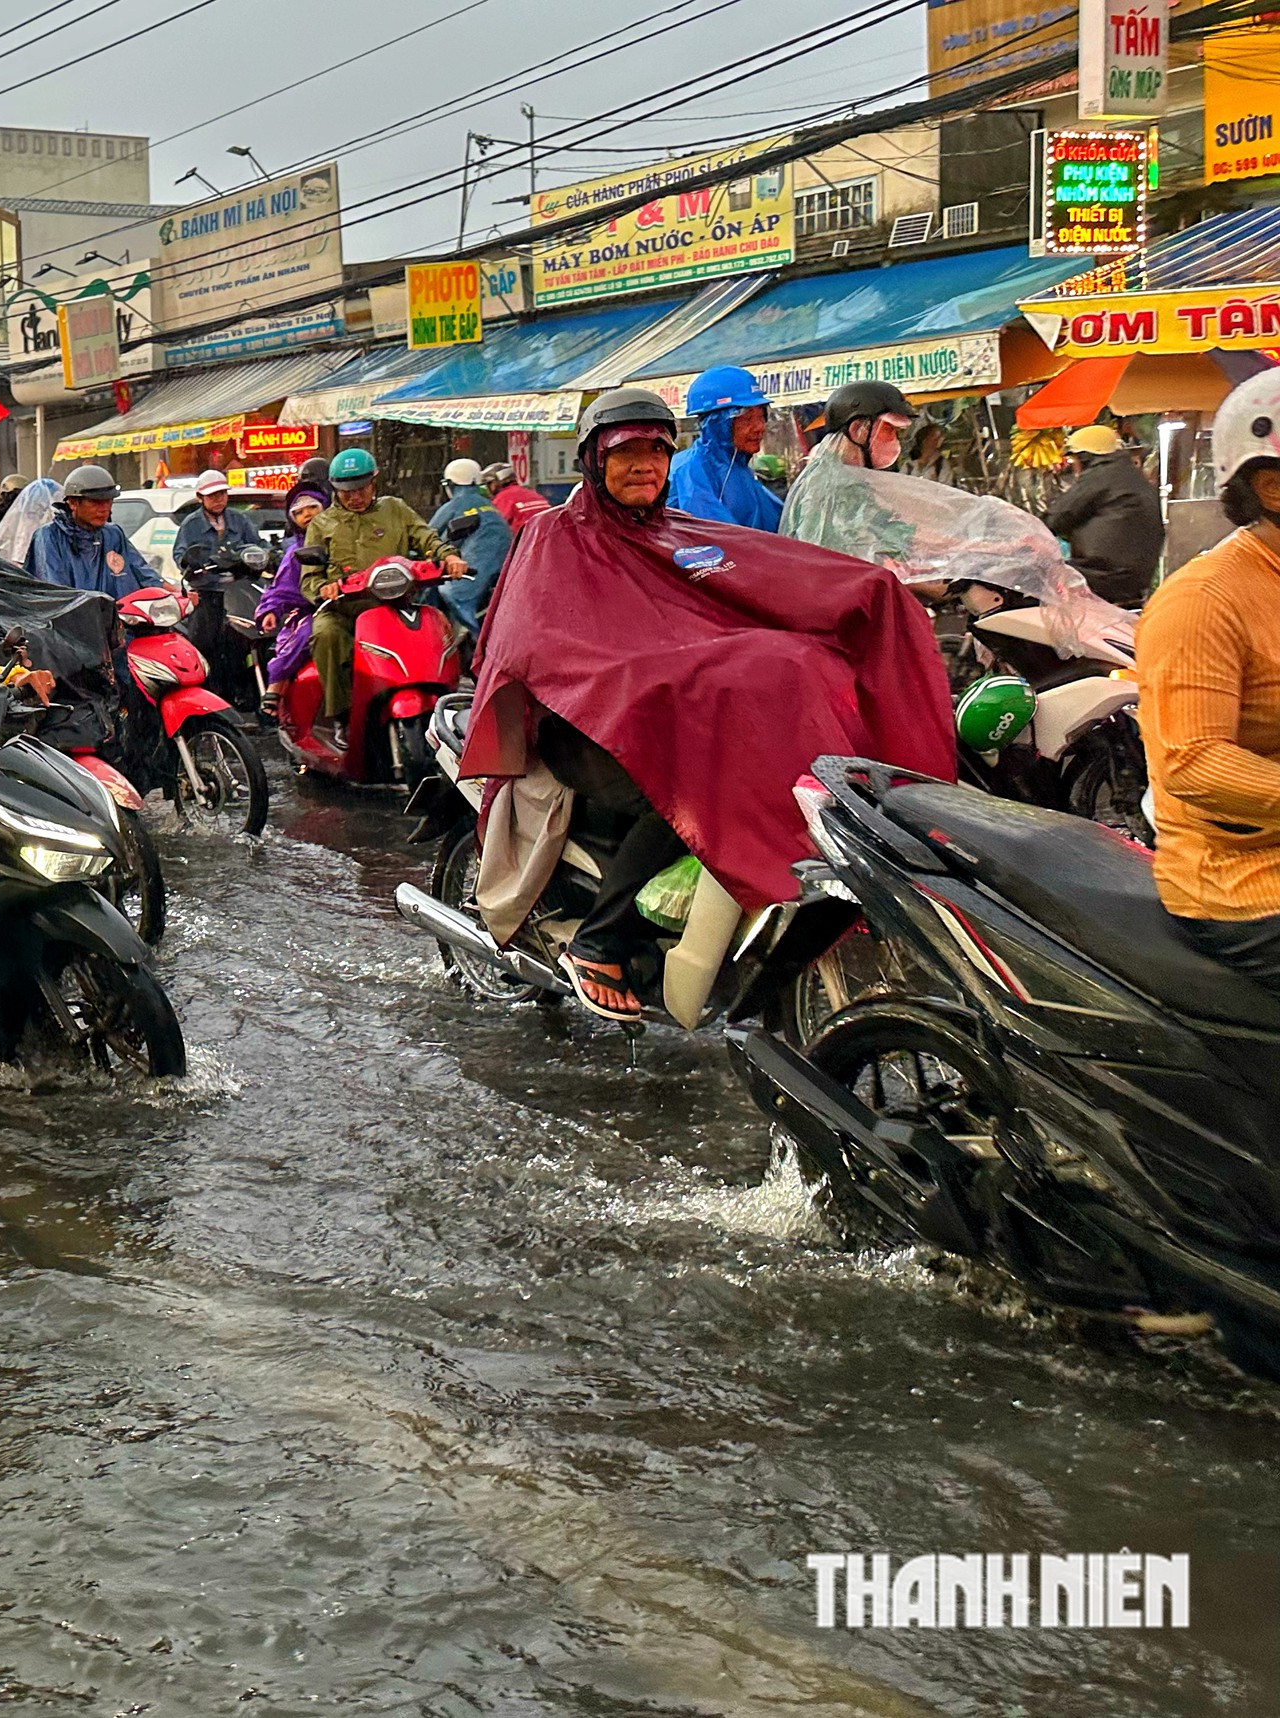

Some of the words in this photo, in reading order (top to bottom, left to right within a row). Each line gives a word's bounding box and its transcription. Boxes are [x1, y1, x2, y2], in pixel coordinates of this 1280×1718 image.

[1111, 5, 1159, 57] TẤM
[1109, 66, 1131, 99] ÔNG
[1135, 67, 1162, 103] MẬP
[1216, 114, 1272, 147] SƯỜN
[1068, 142, 1108, 161] KHÓA
[1109, 142, 1138, 161] CỬA
[1063, 164, 1093, 183] PHỤ
[1095, 162, 1128, 184] KIỆN
[566, 188, 590, 209] CỬA
[593, 184, 624, 203] HÀNG
[1056, 183, 1098, 201] NHÔM
[1100, 181, 1134, 201] KÍNH
[181, 212, 219, 239] BÁNH
[224, 201, 241, 228] MÌ
[246, 194, 266, 221] HÀ
[271, 186, 297, 217] NỘI
[1067, 203, 1106, 222] THIẾT
[543, 251, 583, 273] MÁY
[589, 243, 629, 265] BƠM
[636, 229, 693, 255] NƯỚC
[711, 215, 742, 241] ỔN
[749, 213, 780, 235] ÁP
[1058, 225, 1090, 246] ĐIỆN
[1093, 223, 1132, 242] NƯỚC
[179, 285, 210, 299] CHUYÊN
[277, 263, 310, 278] NHANH
[410, 265, 477, 305] PHOTO
[489, 264, 516, 297] GẤP
[412, 311, 437, 345] HÌNH
[439, 305, 456, 342] THẺ
[459, 303, 477, 340] GẤP
[756, 370, 781, 395] HÔM
[784, 366, 812, 393] KÍNH
[825, 355, 861, 386] THIẾT
[883, 353, 915, 384] ĐIỆN
[919, 346, 958, 376] NƯỚC
[249, 431, 280, 447] BÁNH
[282, 431, 306, 445] BAO
[989, 712, 1015, 741] Grab
